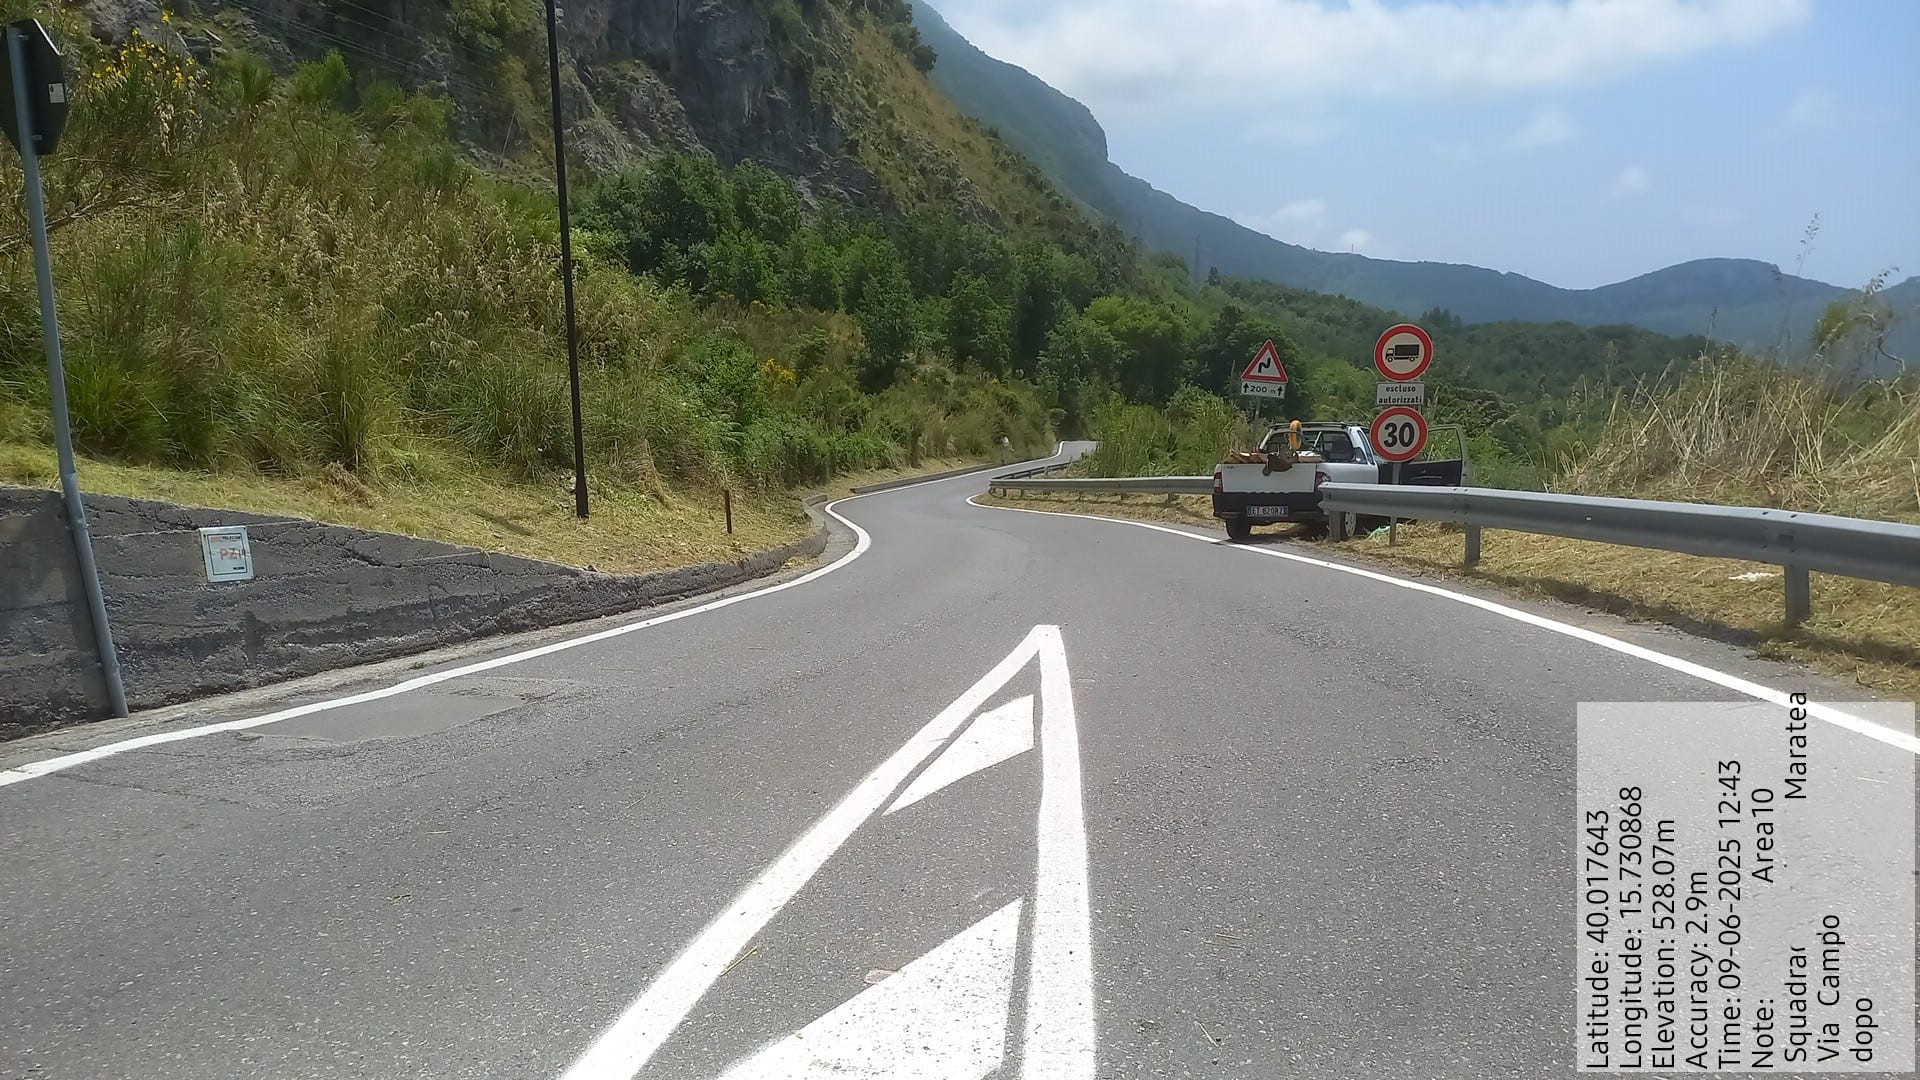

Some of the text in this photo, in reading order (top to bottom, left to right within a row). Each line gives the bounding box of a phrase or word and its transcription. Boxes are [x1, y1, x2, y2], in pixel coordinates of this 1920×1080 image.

[1250, 385, 1267, 393] 200
[1386, 384, 1416, 392] escluso
[1378, 395, 1422, 404] autorizzati
[1383, 422, 1415, 447] 30
